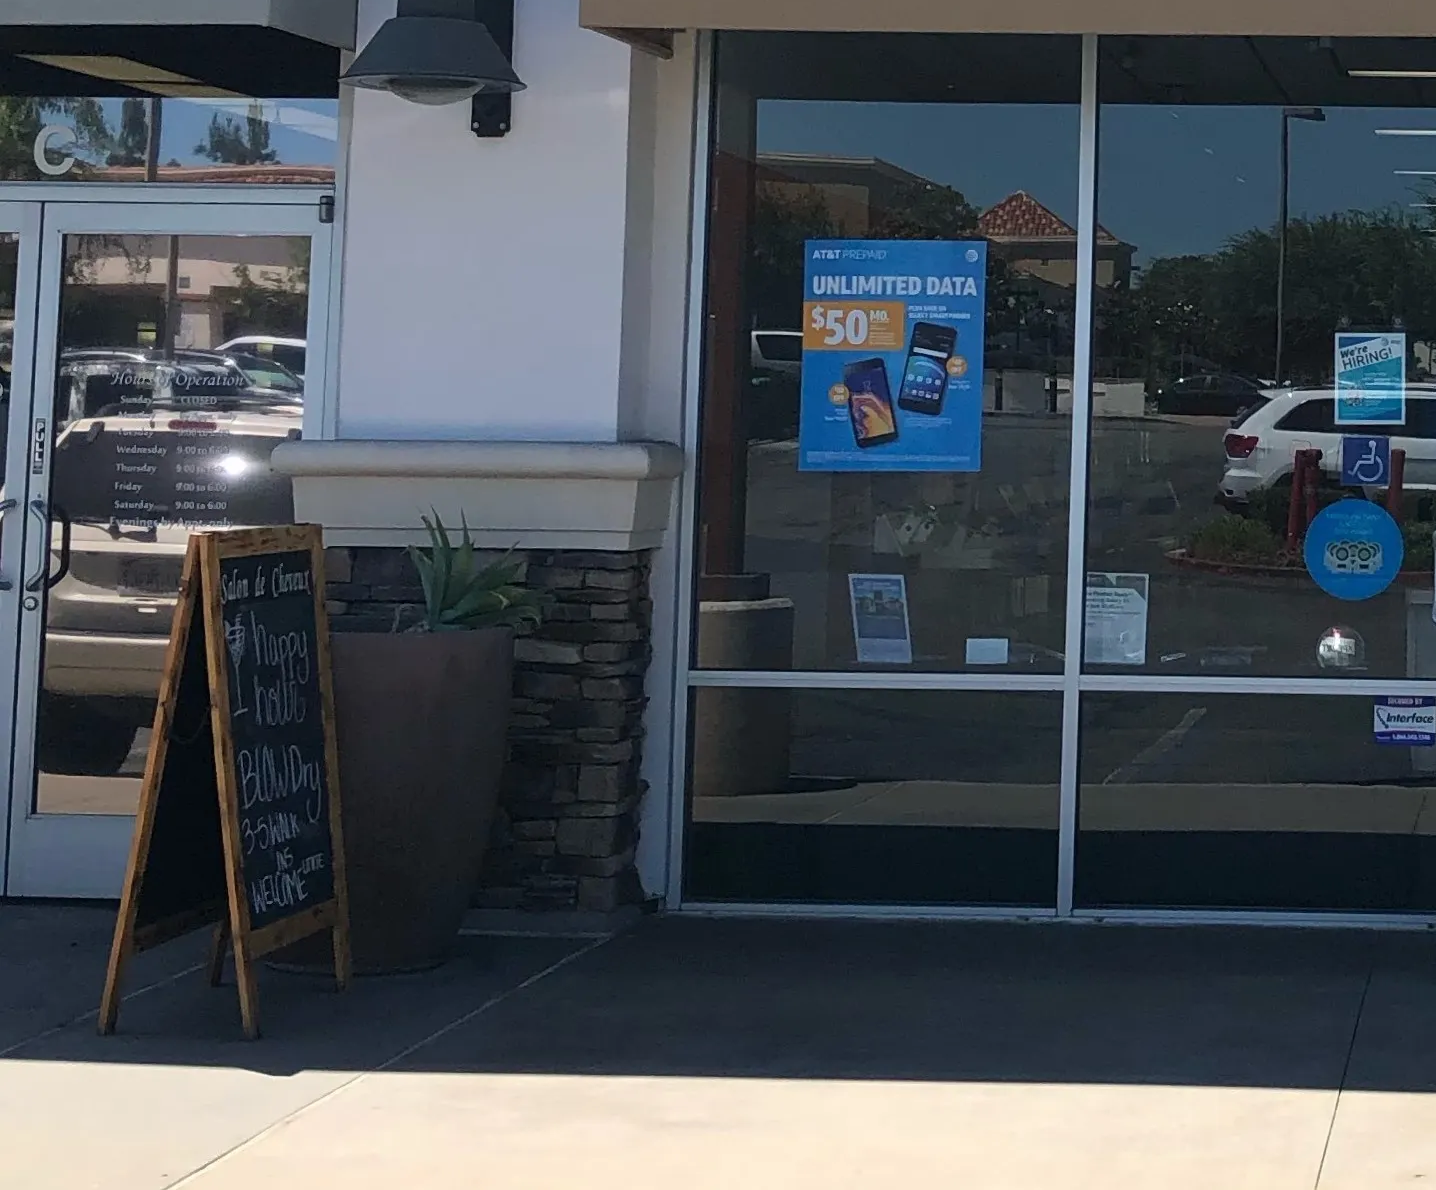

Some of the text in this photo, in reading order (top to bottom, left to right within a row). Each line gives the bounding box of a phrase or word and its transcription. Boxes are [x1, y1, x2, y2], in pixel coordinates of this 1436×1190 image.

[33, 124, 77, 176] C
[812, 249, 887, 260] AT&T PREPAID
[812, 275, 978, 296] UNLIMITED DATA
[811, 306, 868, 346] $50
[869, 310, 890, 322] MO.
[1340, 345, 1369, 359] We're
[1341, 346, 1393, 370] HIRING!
[175, 371, 245, 390] Operation
[119, 395, 153, 407] Sunday
[35, 422, 45, 462] PULL
[116, 444, 168, 457] Wednesday
[115, 463, 158, 475] Thursday
[114, 481, 143, 494] Friday
[113, 499, 155, 512] Saturday
[220, 568, 249, 605] Salon
[255, 565, 266, 598] de
[250, 609, 310, 685] happy
[1386, 712, 1434, 724] Interface
[289, 744, 322, 825] Dry
[251, 869, 308, 914] WELCOME
